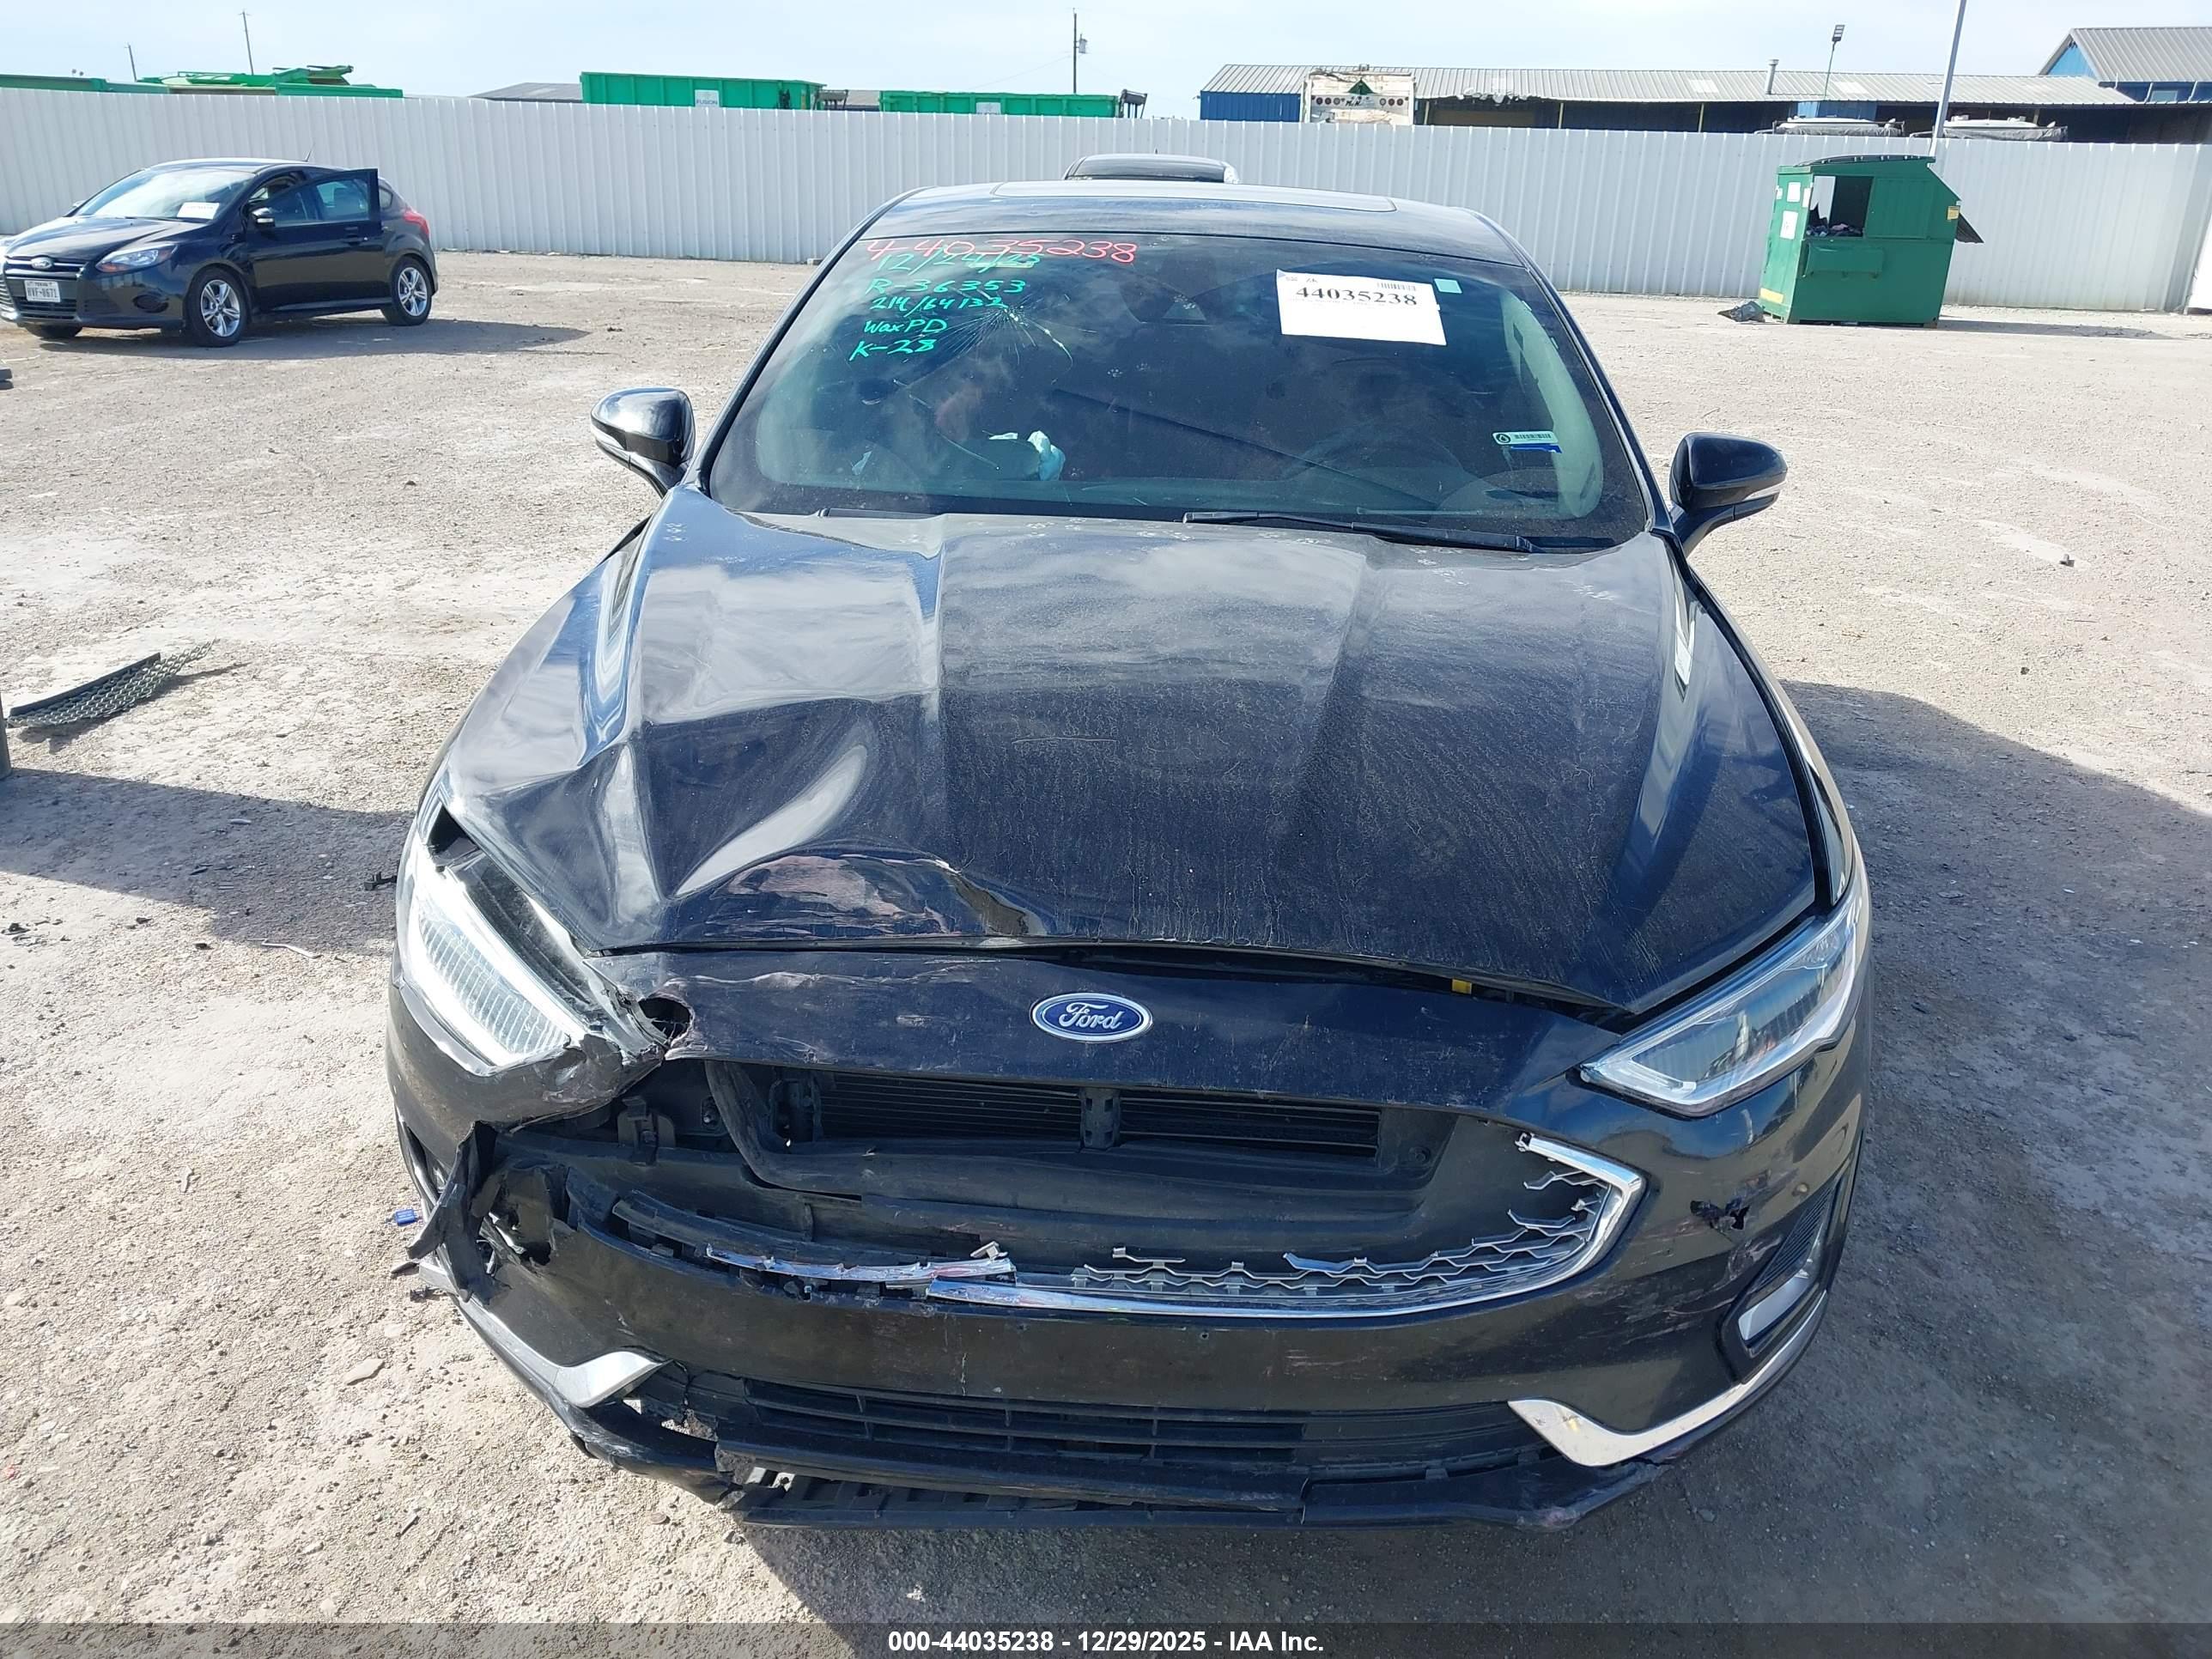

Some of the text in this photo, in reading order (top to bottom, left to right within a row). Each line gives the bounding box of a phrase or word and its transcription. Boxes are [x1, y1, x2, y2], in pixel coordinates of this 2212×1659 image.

[866, 279, 1025, 294] R-36353
[1296, 286, 1418, 306] 44035238
[1059, 1002, 1125, 1030] Ford
